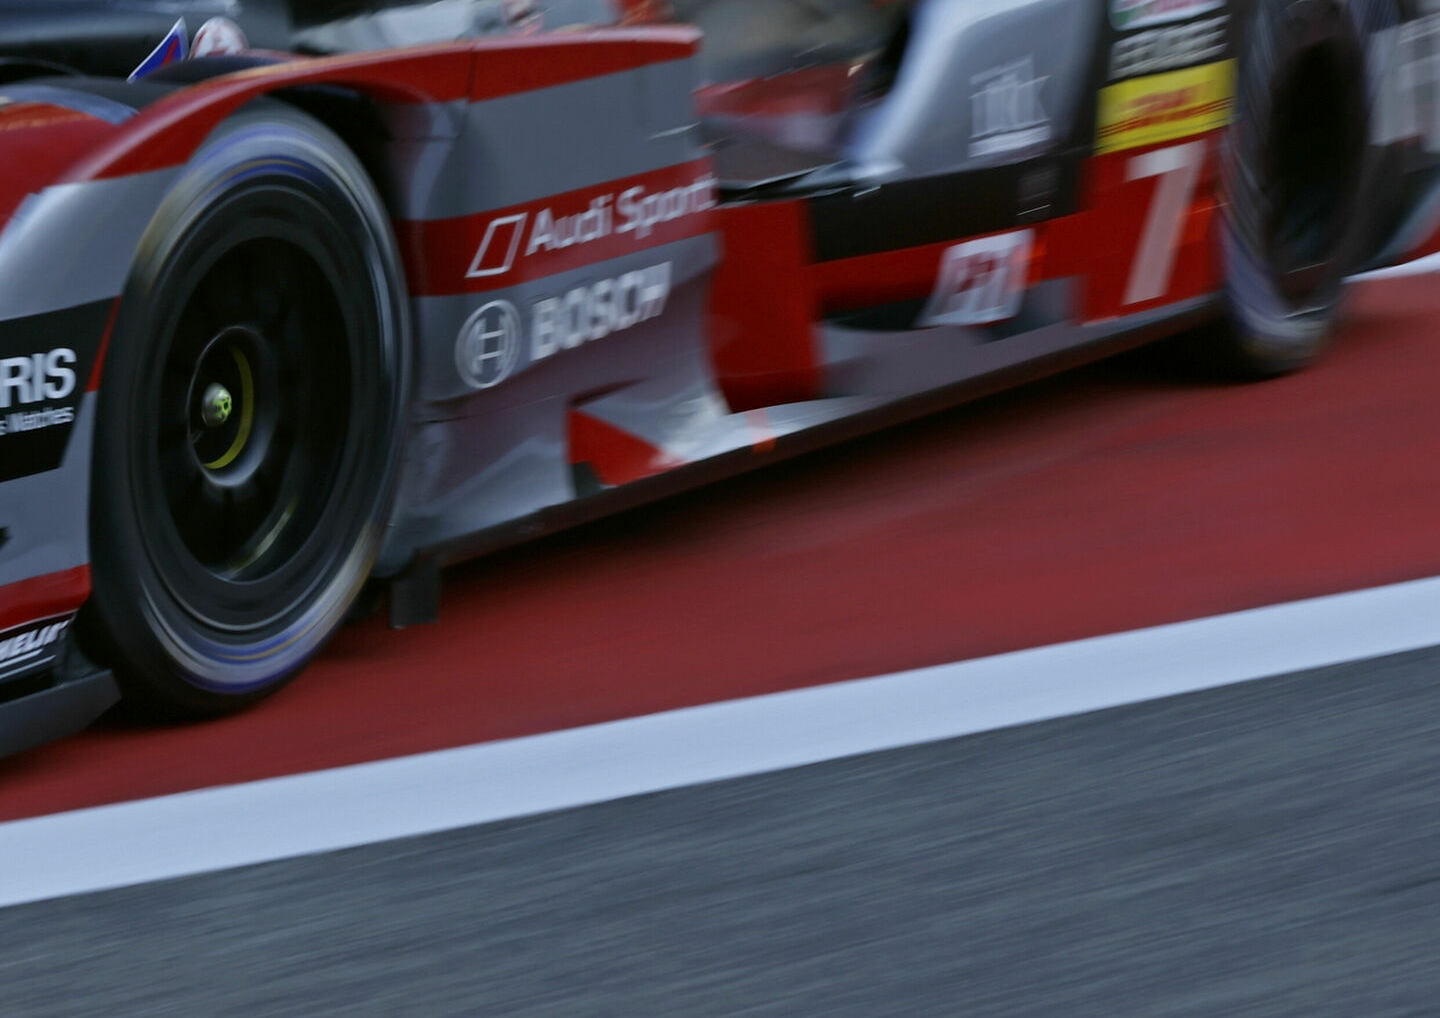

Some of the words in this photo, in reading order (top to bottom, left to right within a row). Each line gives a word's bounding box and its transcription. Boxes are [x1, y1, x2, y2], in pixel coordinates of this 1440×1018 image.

[525, 193, 613, 256] Audi
[615, 170, 718, 240] Sport
[1122, 139, 1208, 306] 7
[530, 260, 672, 362] BOSCH
